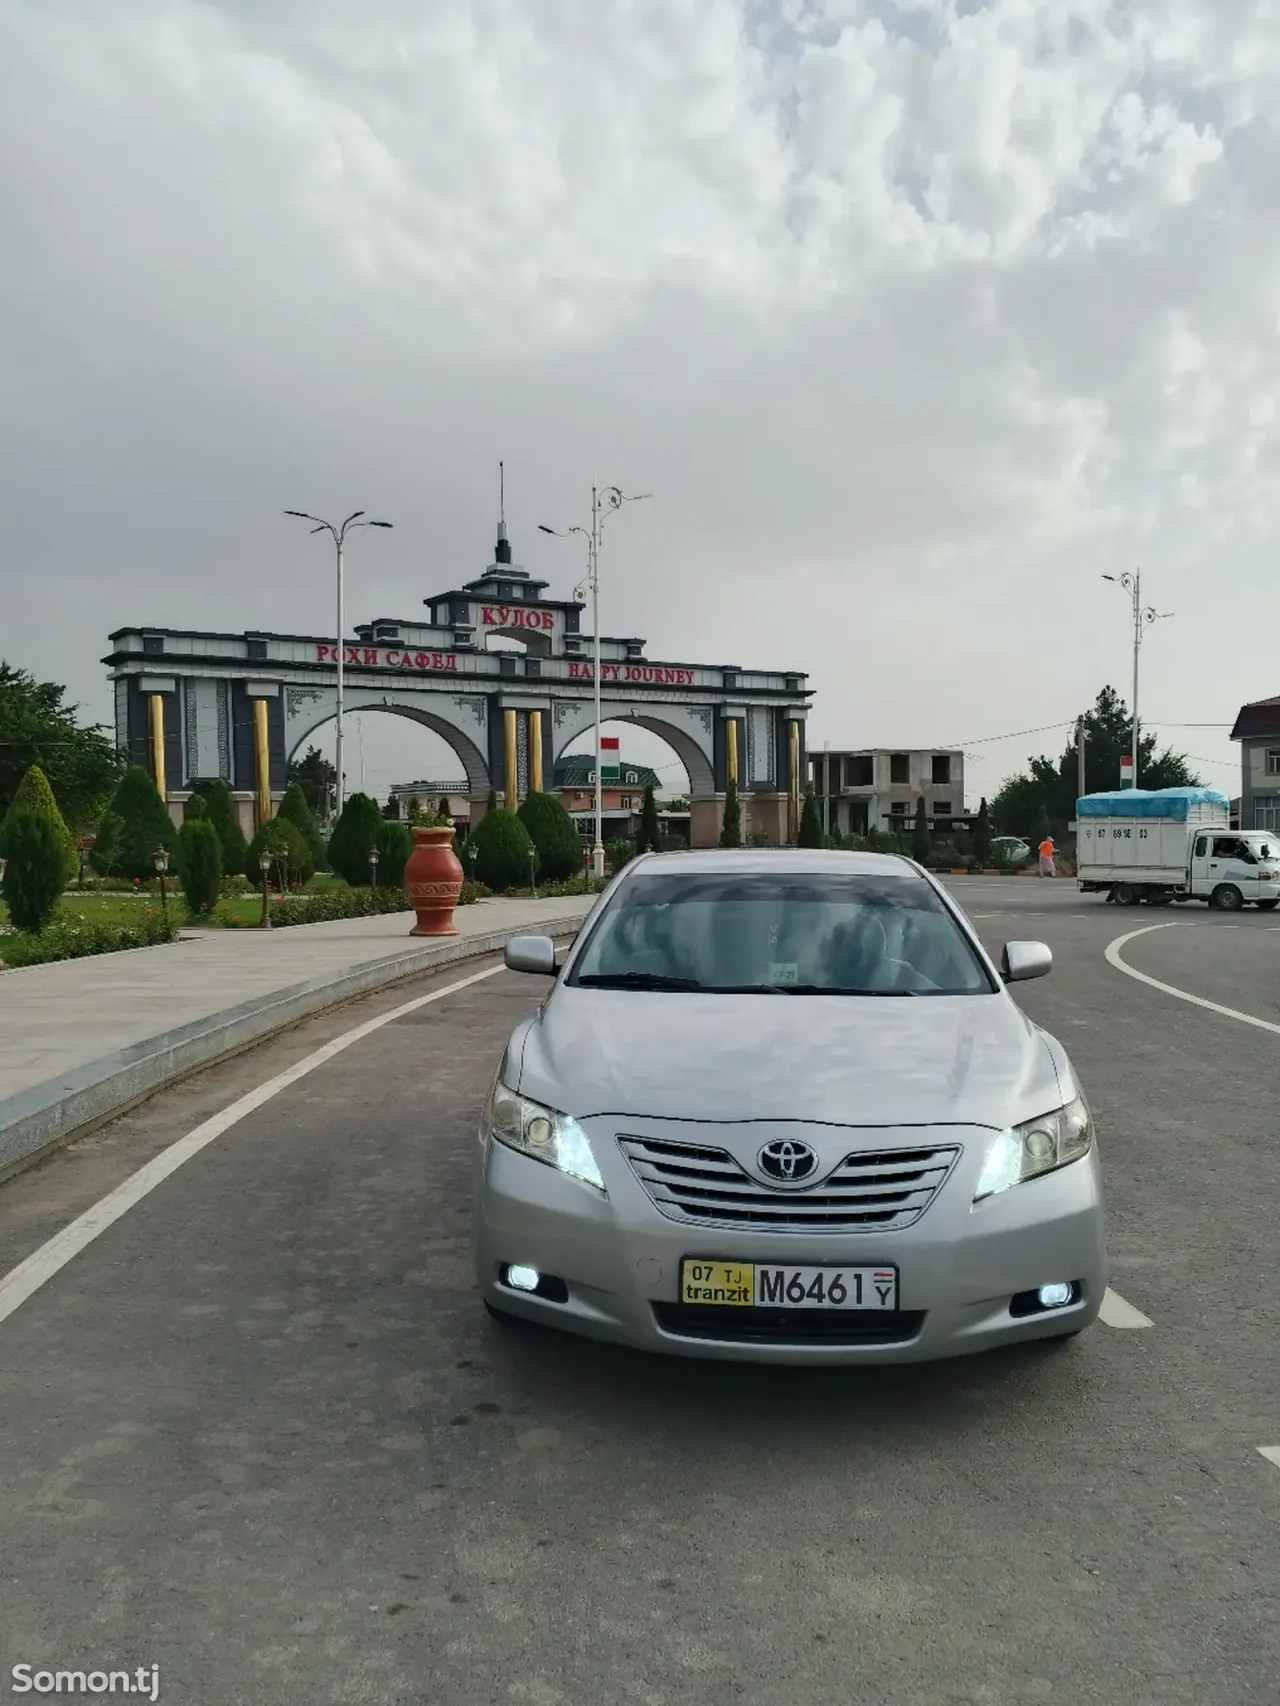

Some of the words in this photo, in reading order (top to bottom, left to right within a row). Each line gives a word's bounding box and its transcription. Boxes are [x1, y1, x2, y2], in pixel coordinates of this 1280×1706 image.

[386, 651, 458, 670] САФЕД
[624, 666, 695, 684] JOURNEY
[692, 1266, 714, 1282] 07
[724, 1269, 742, 1284] TJ
[686, 1284, 750, 1302] tranzit
[760, 1269, 864, 1305] M6461
[875, 1285, 893, 1306] Y
